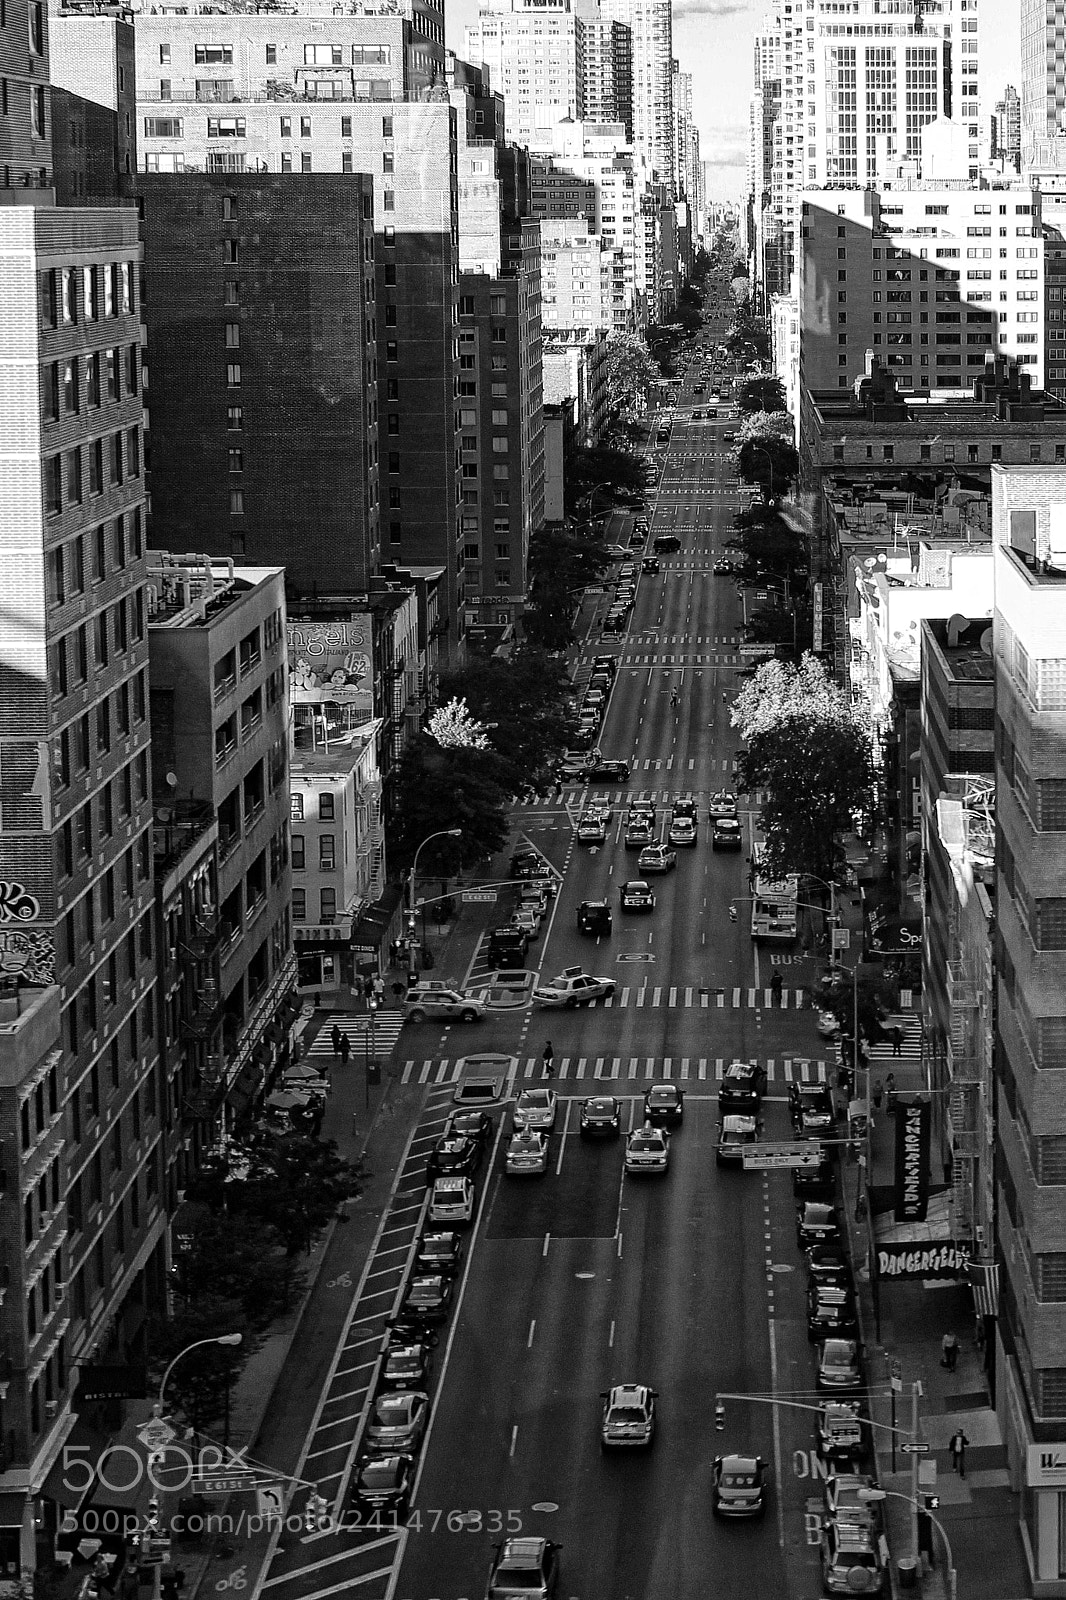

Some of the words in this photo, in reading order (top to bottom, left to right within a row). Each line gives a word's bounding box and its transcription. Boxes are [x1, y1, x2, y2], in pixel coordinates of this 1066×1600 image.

[287, 624, 364, 656] ngels
[351, 661, 366, 673] 62
[296, 929, 342, 940] DINER
[770, 954, 803, 965] BUS
[205, 1482, 212, 1490] E
[214, 1481, 227, 1490] 61
